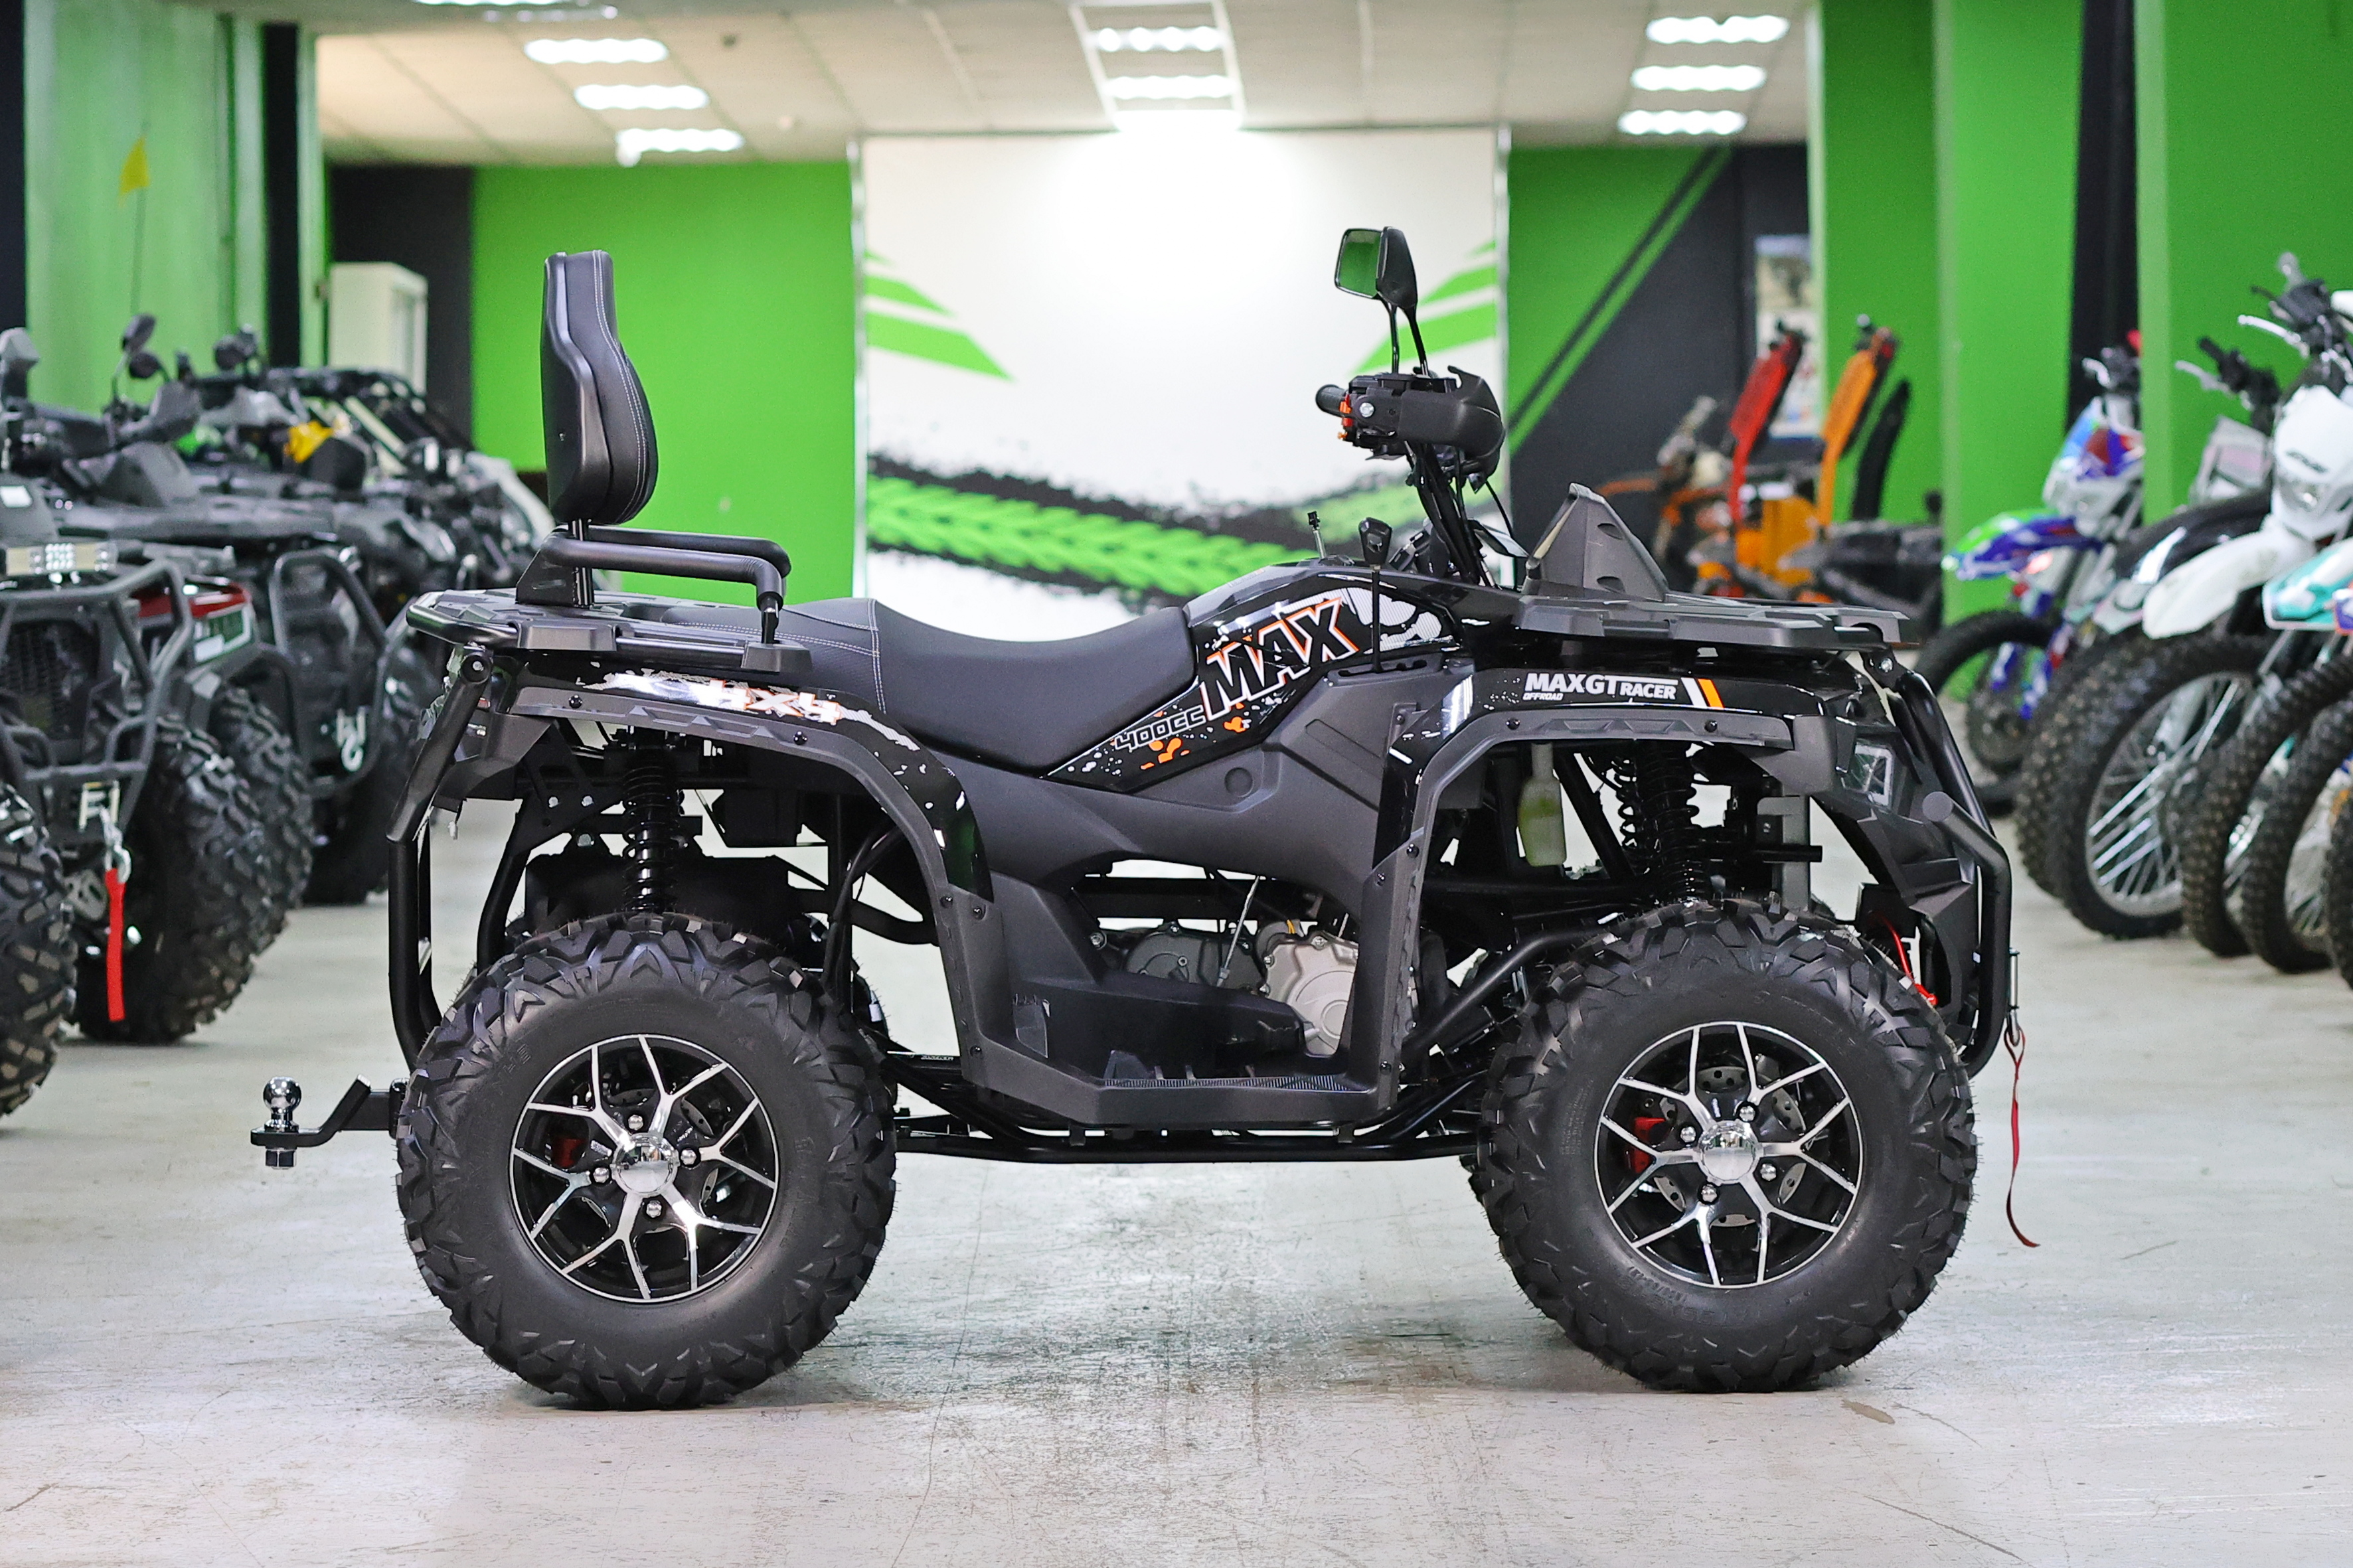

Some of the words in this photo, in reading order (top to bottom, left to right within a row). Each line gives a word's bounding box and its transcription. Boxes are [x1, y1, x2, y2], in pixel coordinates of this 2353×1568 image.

[1200, 597, 1359, 721] MAX
[1522, 692, 1564, 701] OFFROAD
[1620, 682, 1677, 700] RACER
